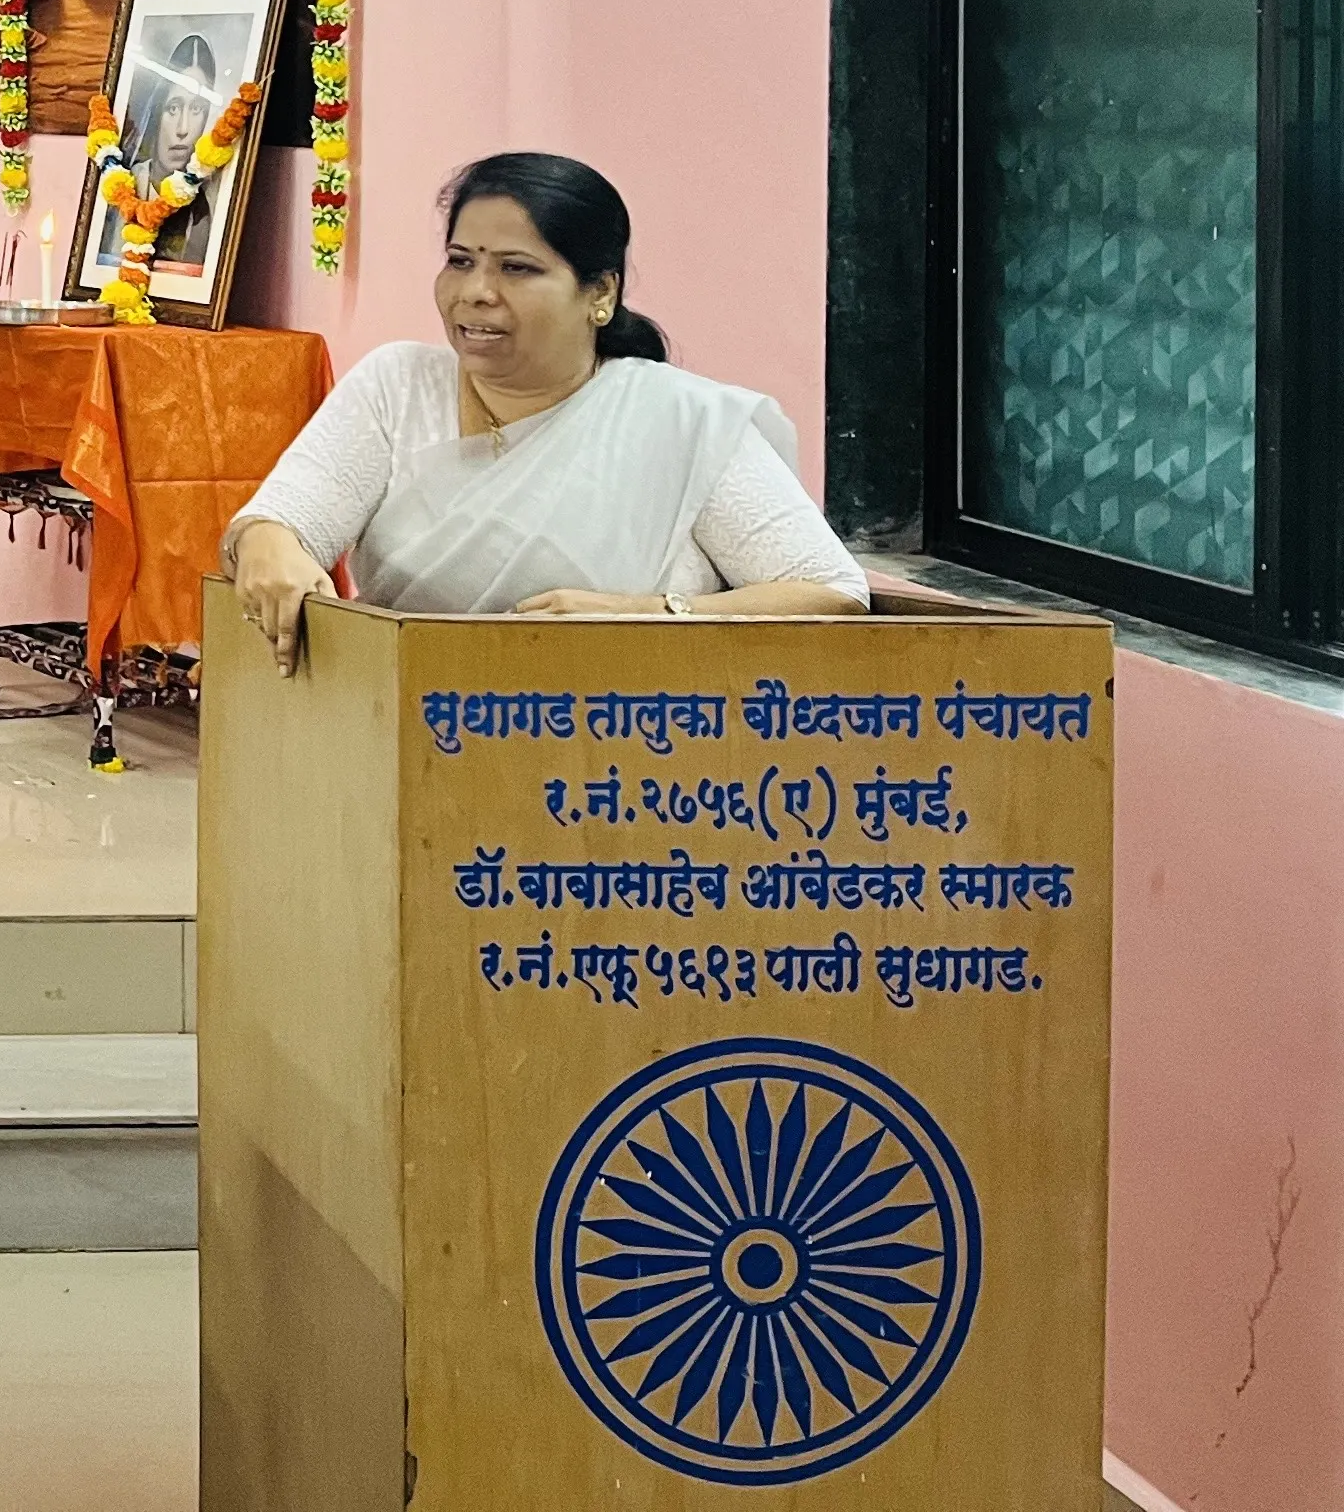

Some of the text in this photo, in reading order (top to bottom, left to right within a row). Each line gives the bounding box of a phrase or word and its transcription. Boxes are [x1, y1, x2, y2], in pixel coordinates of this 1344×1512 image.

[422, 691, 577, 755] सुधागड
[585, 691, 727, 756] तालुका
[935, 680, 1092, 742] पंचायत
[854, 765, 970, 842] मुंबई,
[741, 848, 926, 912] आंबेडकर
[939, 862, 1074, 912] स्मारक
[765, 931, 862, 993] पाली
[875, 945, 1043, 1008] सुधागड.
